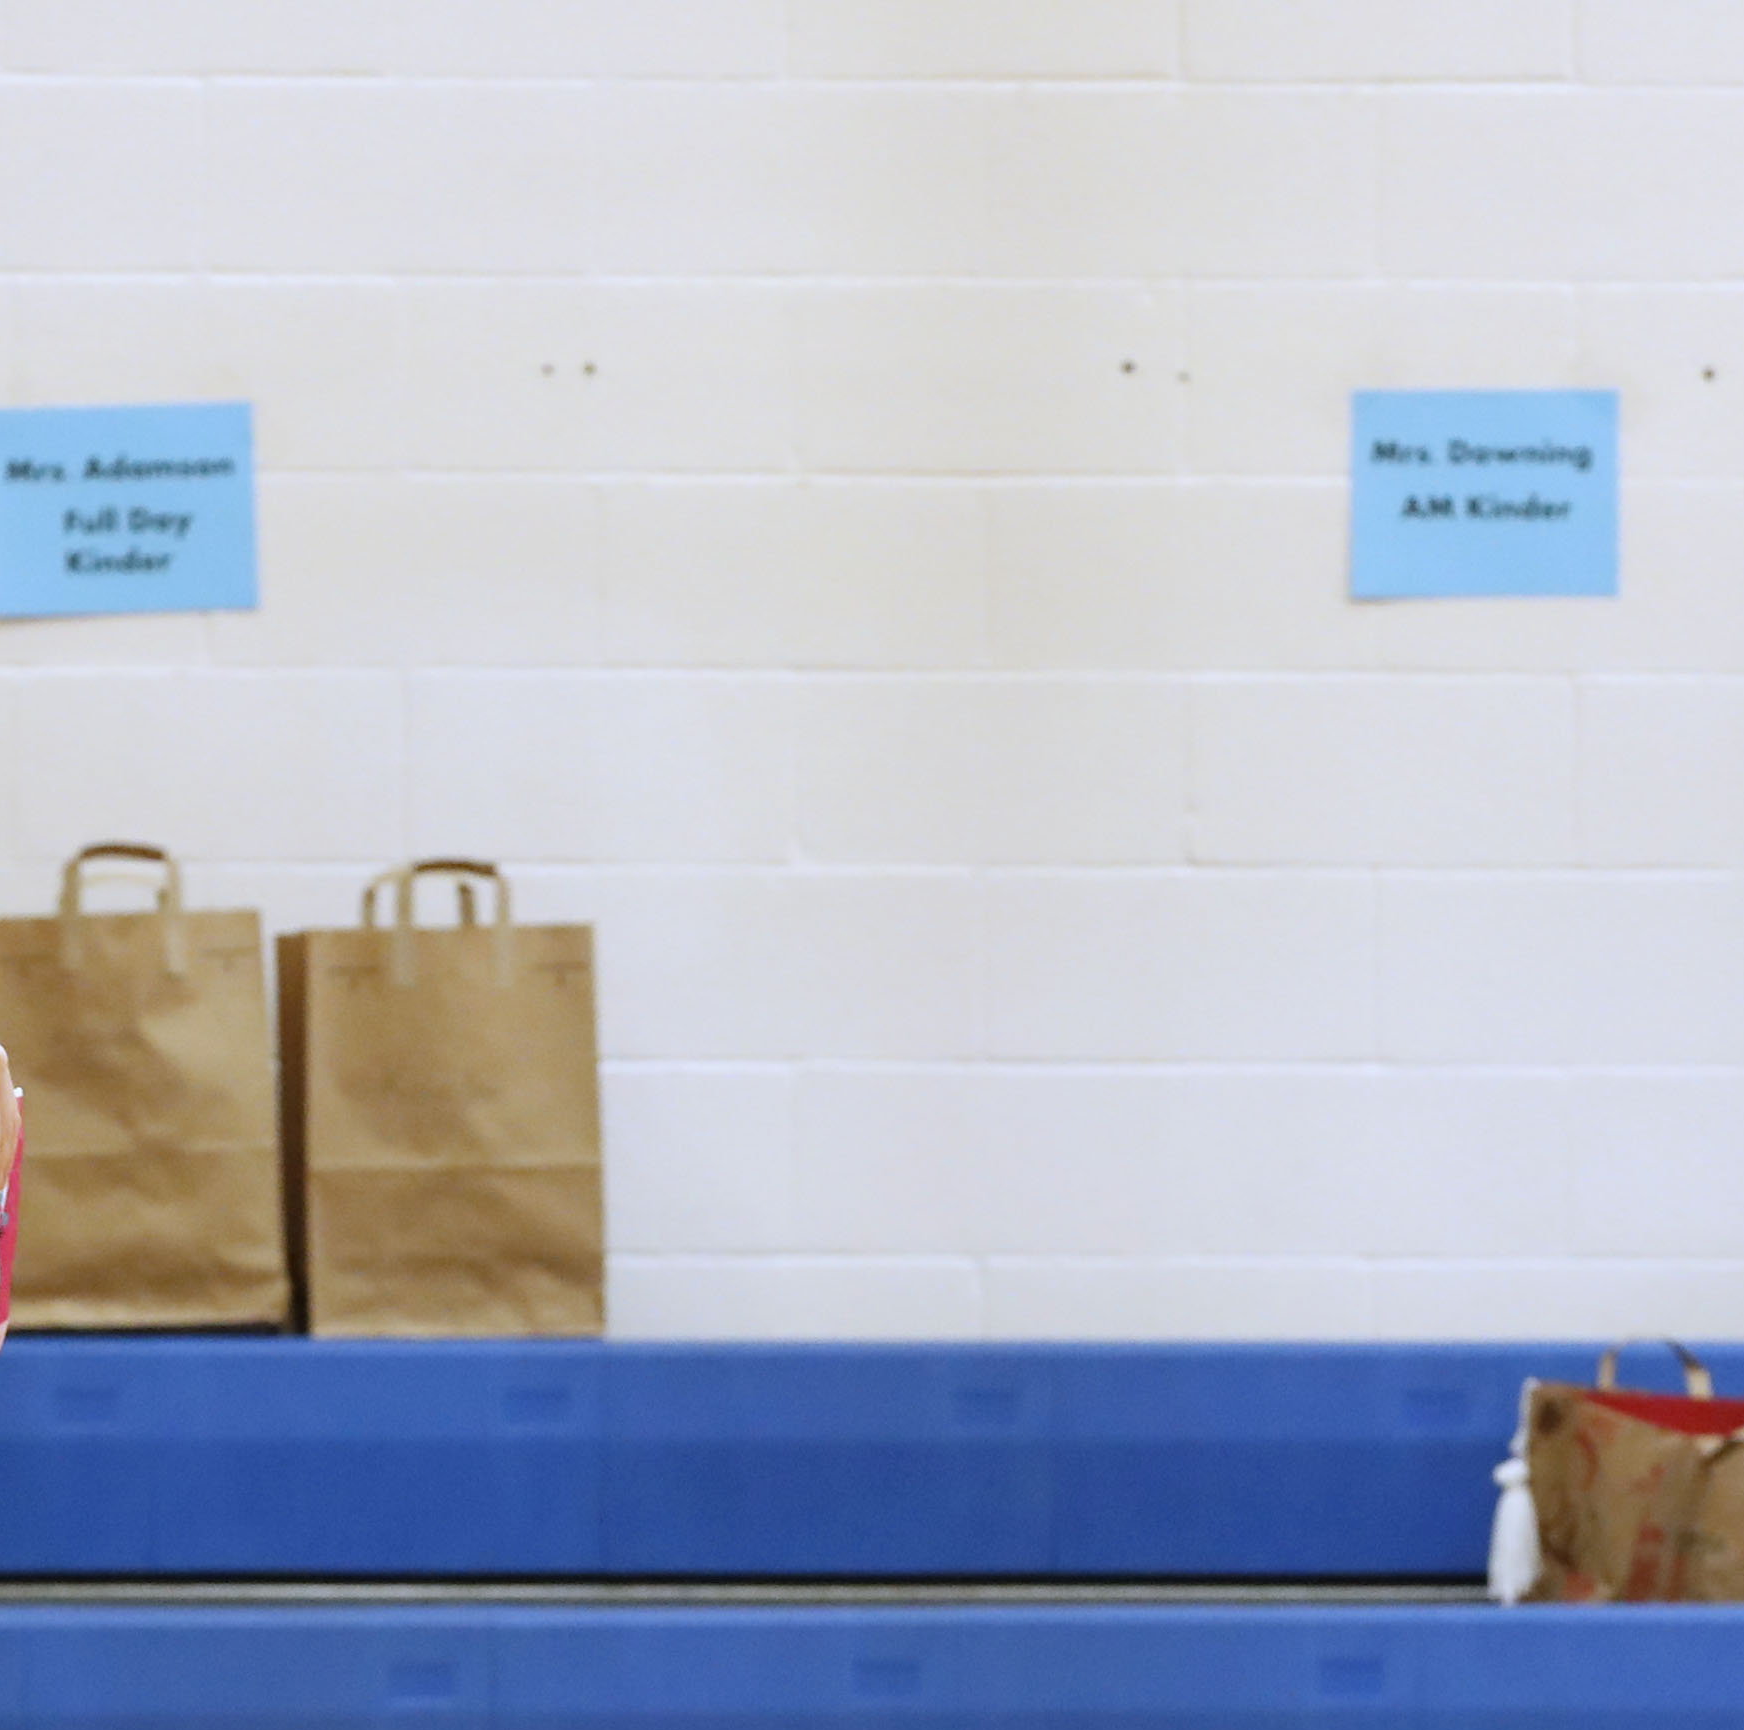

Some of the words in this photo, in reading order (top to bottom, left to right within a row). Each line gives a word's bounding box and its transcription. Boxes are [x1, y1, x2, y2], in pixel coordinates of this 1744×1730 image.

[83, 452, 235, 480] Adamson
[1447, 436, 1595, 473] Downing
[1402, 494, 1454, 519] AM
[1465, 491, 1572, 521] Kinder
[63, 506, 119, 535] Full
[126, 506, 193, 540] Day
[64, 547, 171, 574] Kinder
